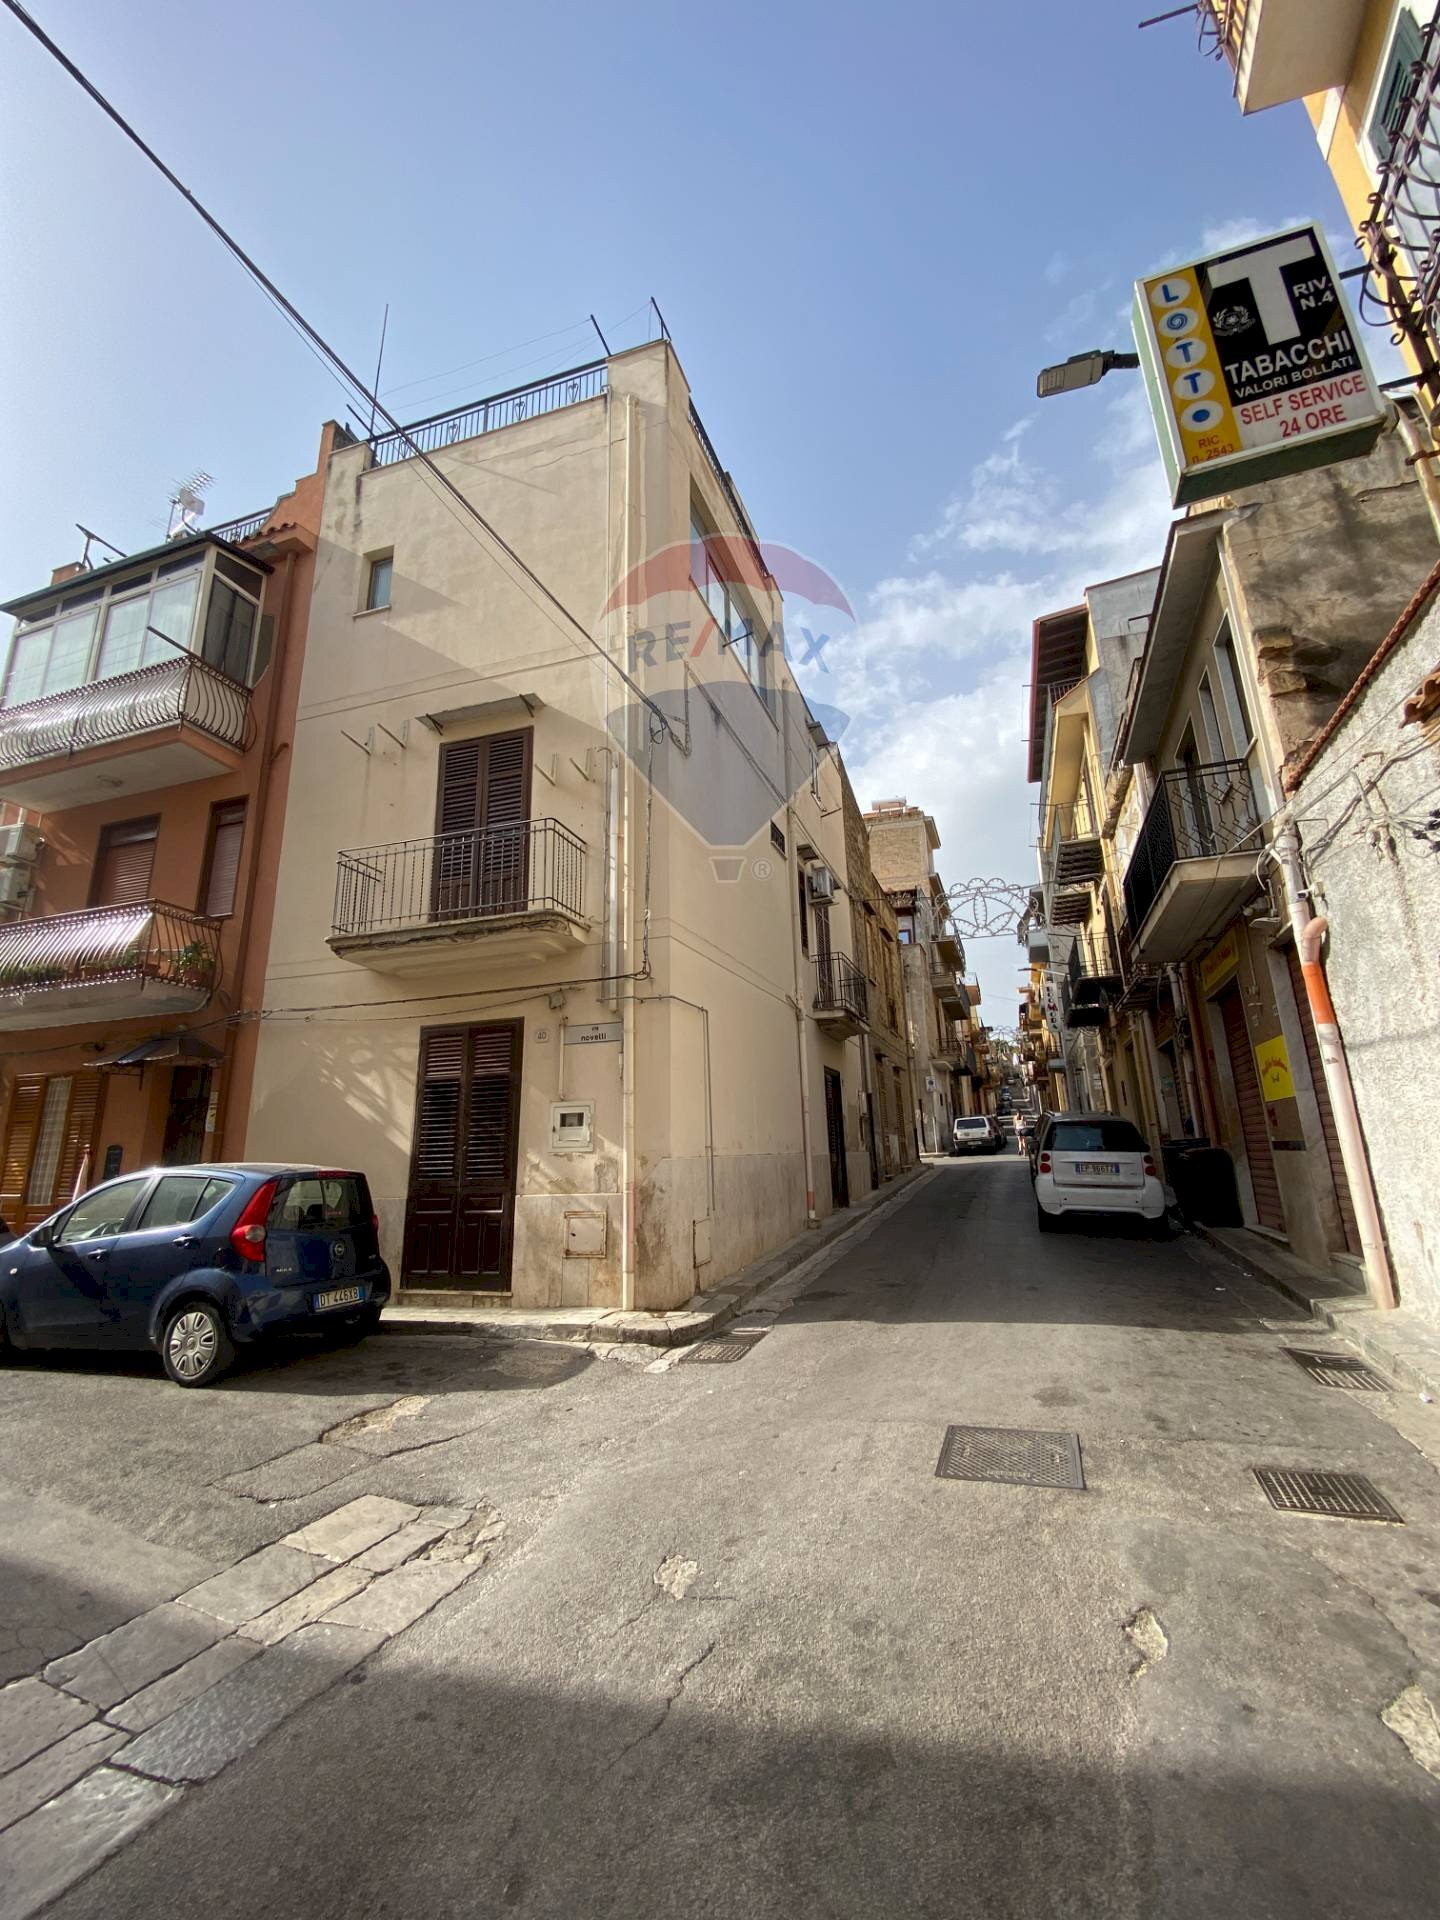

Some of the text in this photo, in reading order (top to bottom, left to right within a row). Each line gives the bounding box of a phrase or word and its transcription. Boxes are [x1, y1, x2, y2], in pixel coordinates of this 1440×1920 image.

[1207, 234, 1316, 346] T
[1292, 276, 1333, 298] RIV.
[1299, 293, 1335, 311] N.4
[1161, 283, 1212, 423] LOTTO
[1225, 330, 1352, 385] TABACCHI
[1235, 356, 1354, 398] VALORI BOLLATI
[1240, 374, 1367, 425] SELF SERVICE
[1280, 404, 1347, 438] 24 ORE
[1206, 444, 1235, 462] 2543
[320, 1294, 330, 1306] DT
